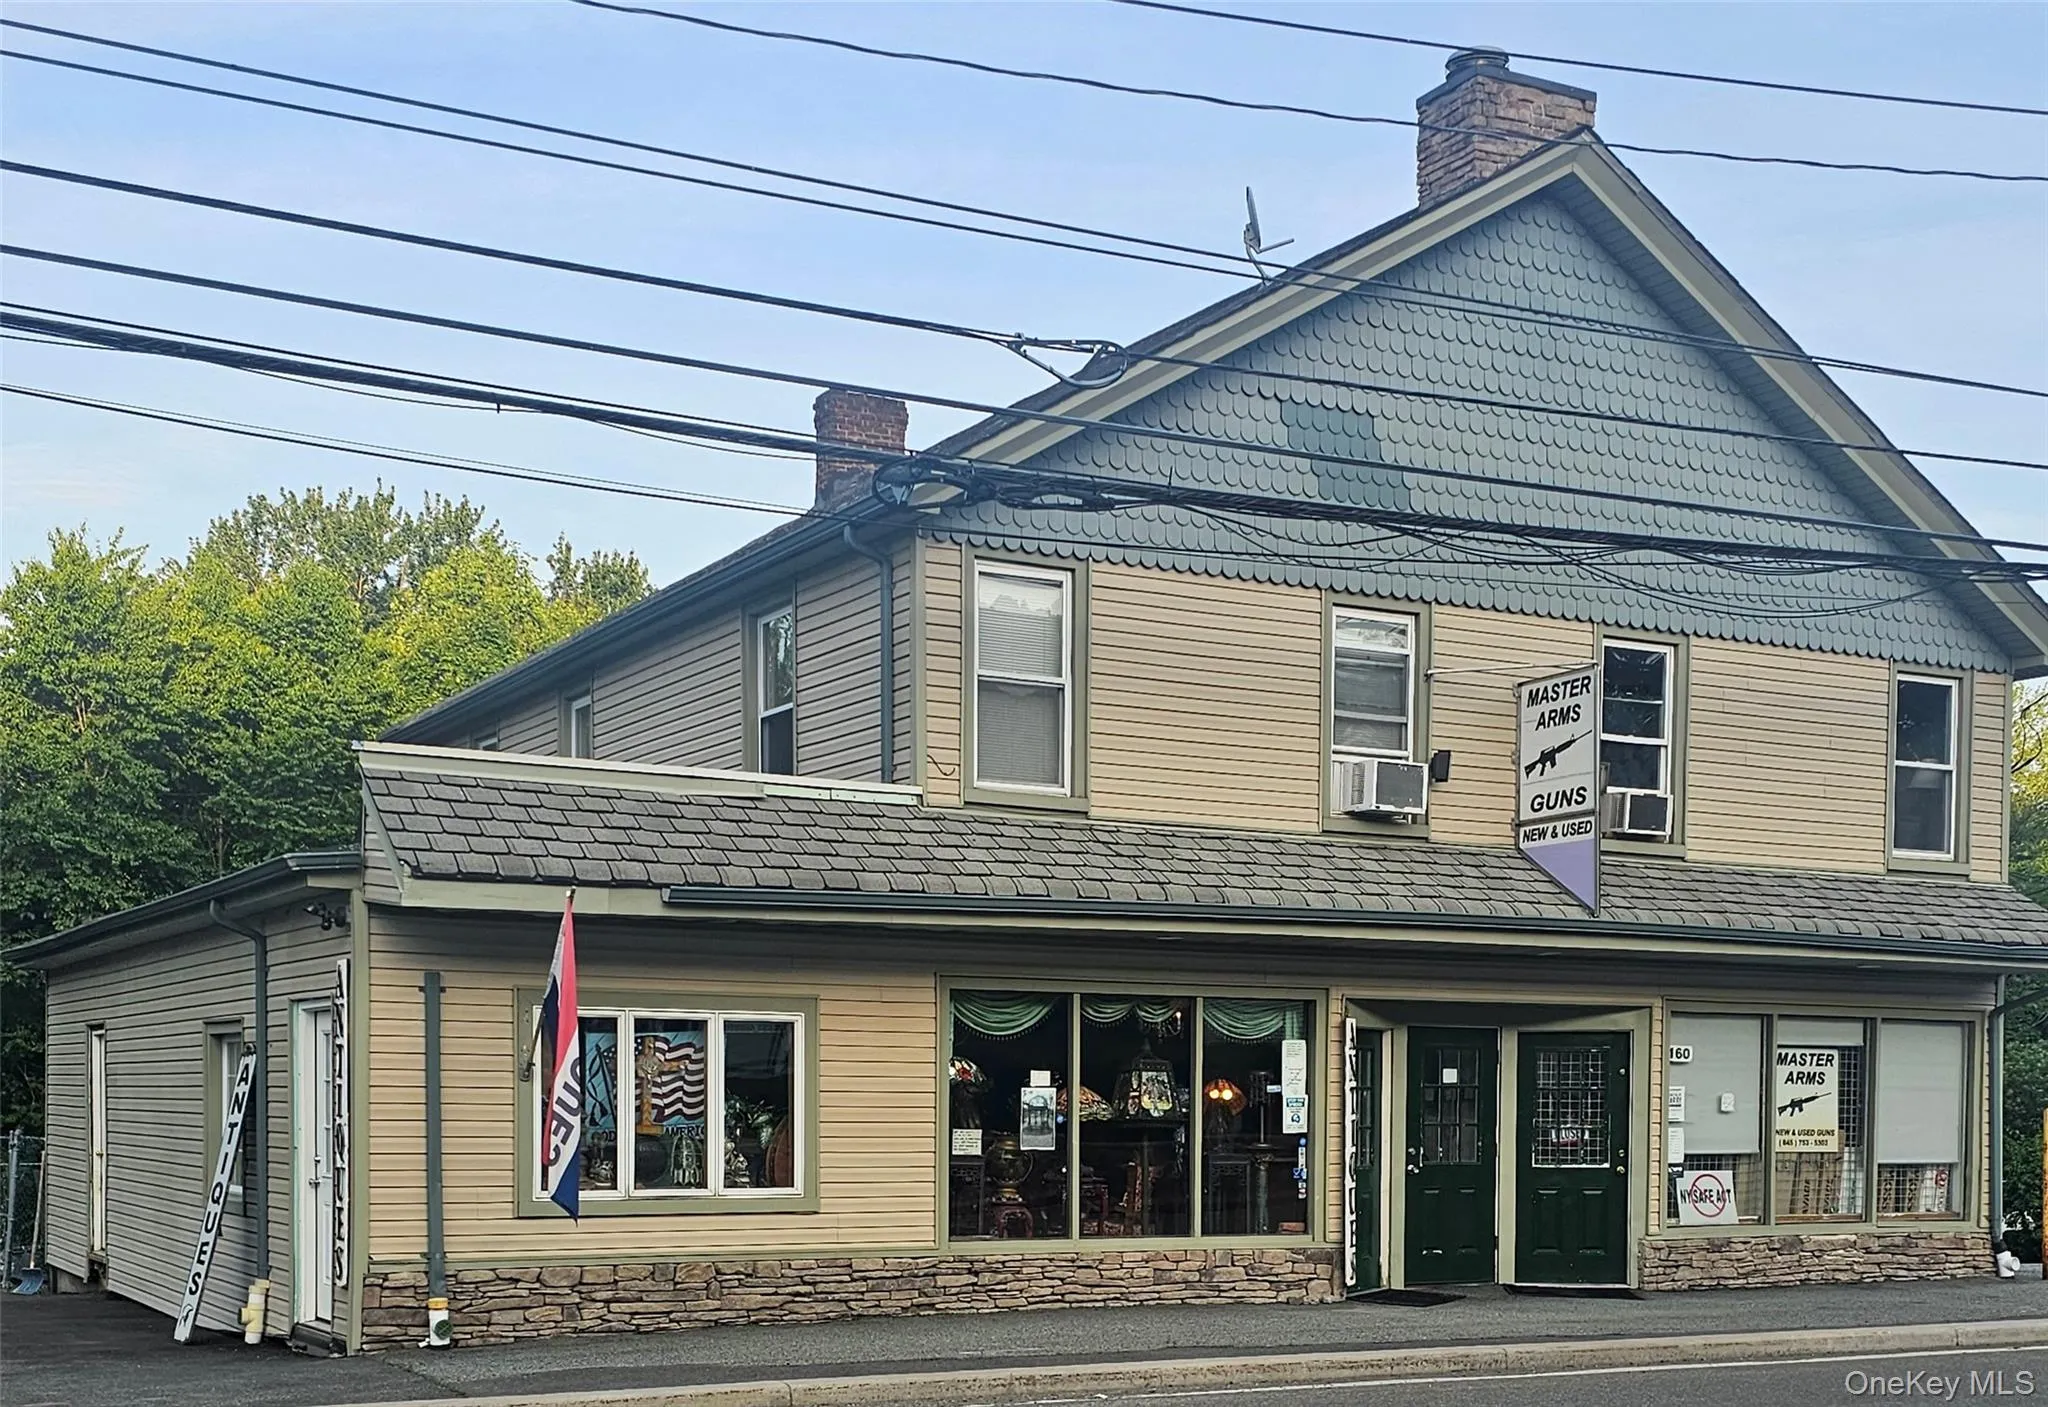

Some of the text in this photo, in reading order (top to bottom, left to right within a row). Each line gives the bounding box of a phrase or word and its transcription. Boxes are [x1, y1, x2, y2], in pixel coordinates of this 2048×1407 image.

[1527, 675, 1592, 708] MASTER
[1535, 703, 1582, 731] ARMS
[1530, 786, 1588, 813] GUNS
[1522, 819, 1593, 843] NEW & USED
[1669, 1047, 1691, 1060] 160
[1776, 1052, 1835, 1067] MASTER
[1784, 1071, 1826, 1085] ARMS
[334, 964, 346, 1280] ANTIQUES
[187, 1063, 250, 1296] ANTIQUES
[1680, 1189, 1692, 1204] NY
[1693, 1188, 1714, 1204] SAFE
